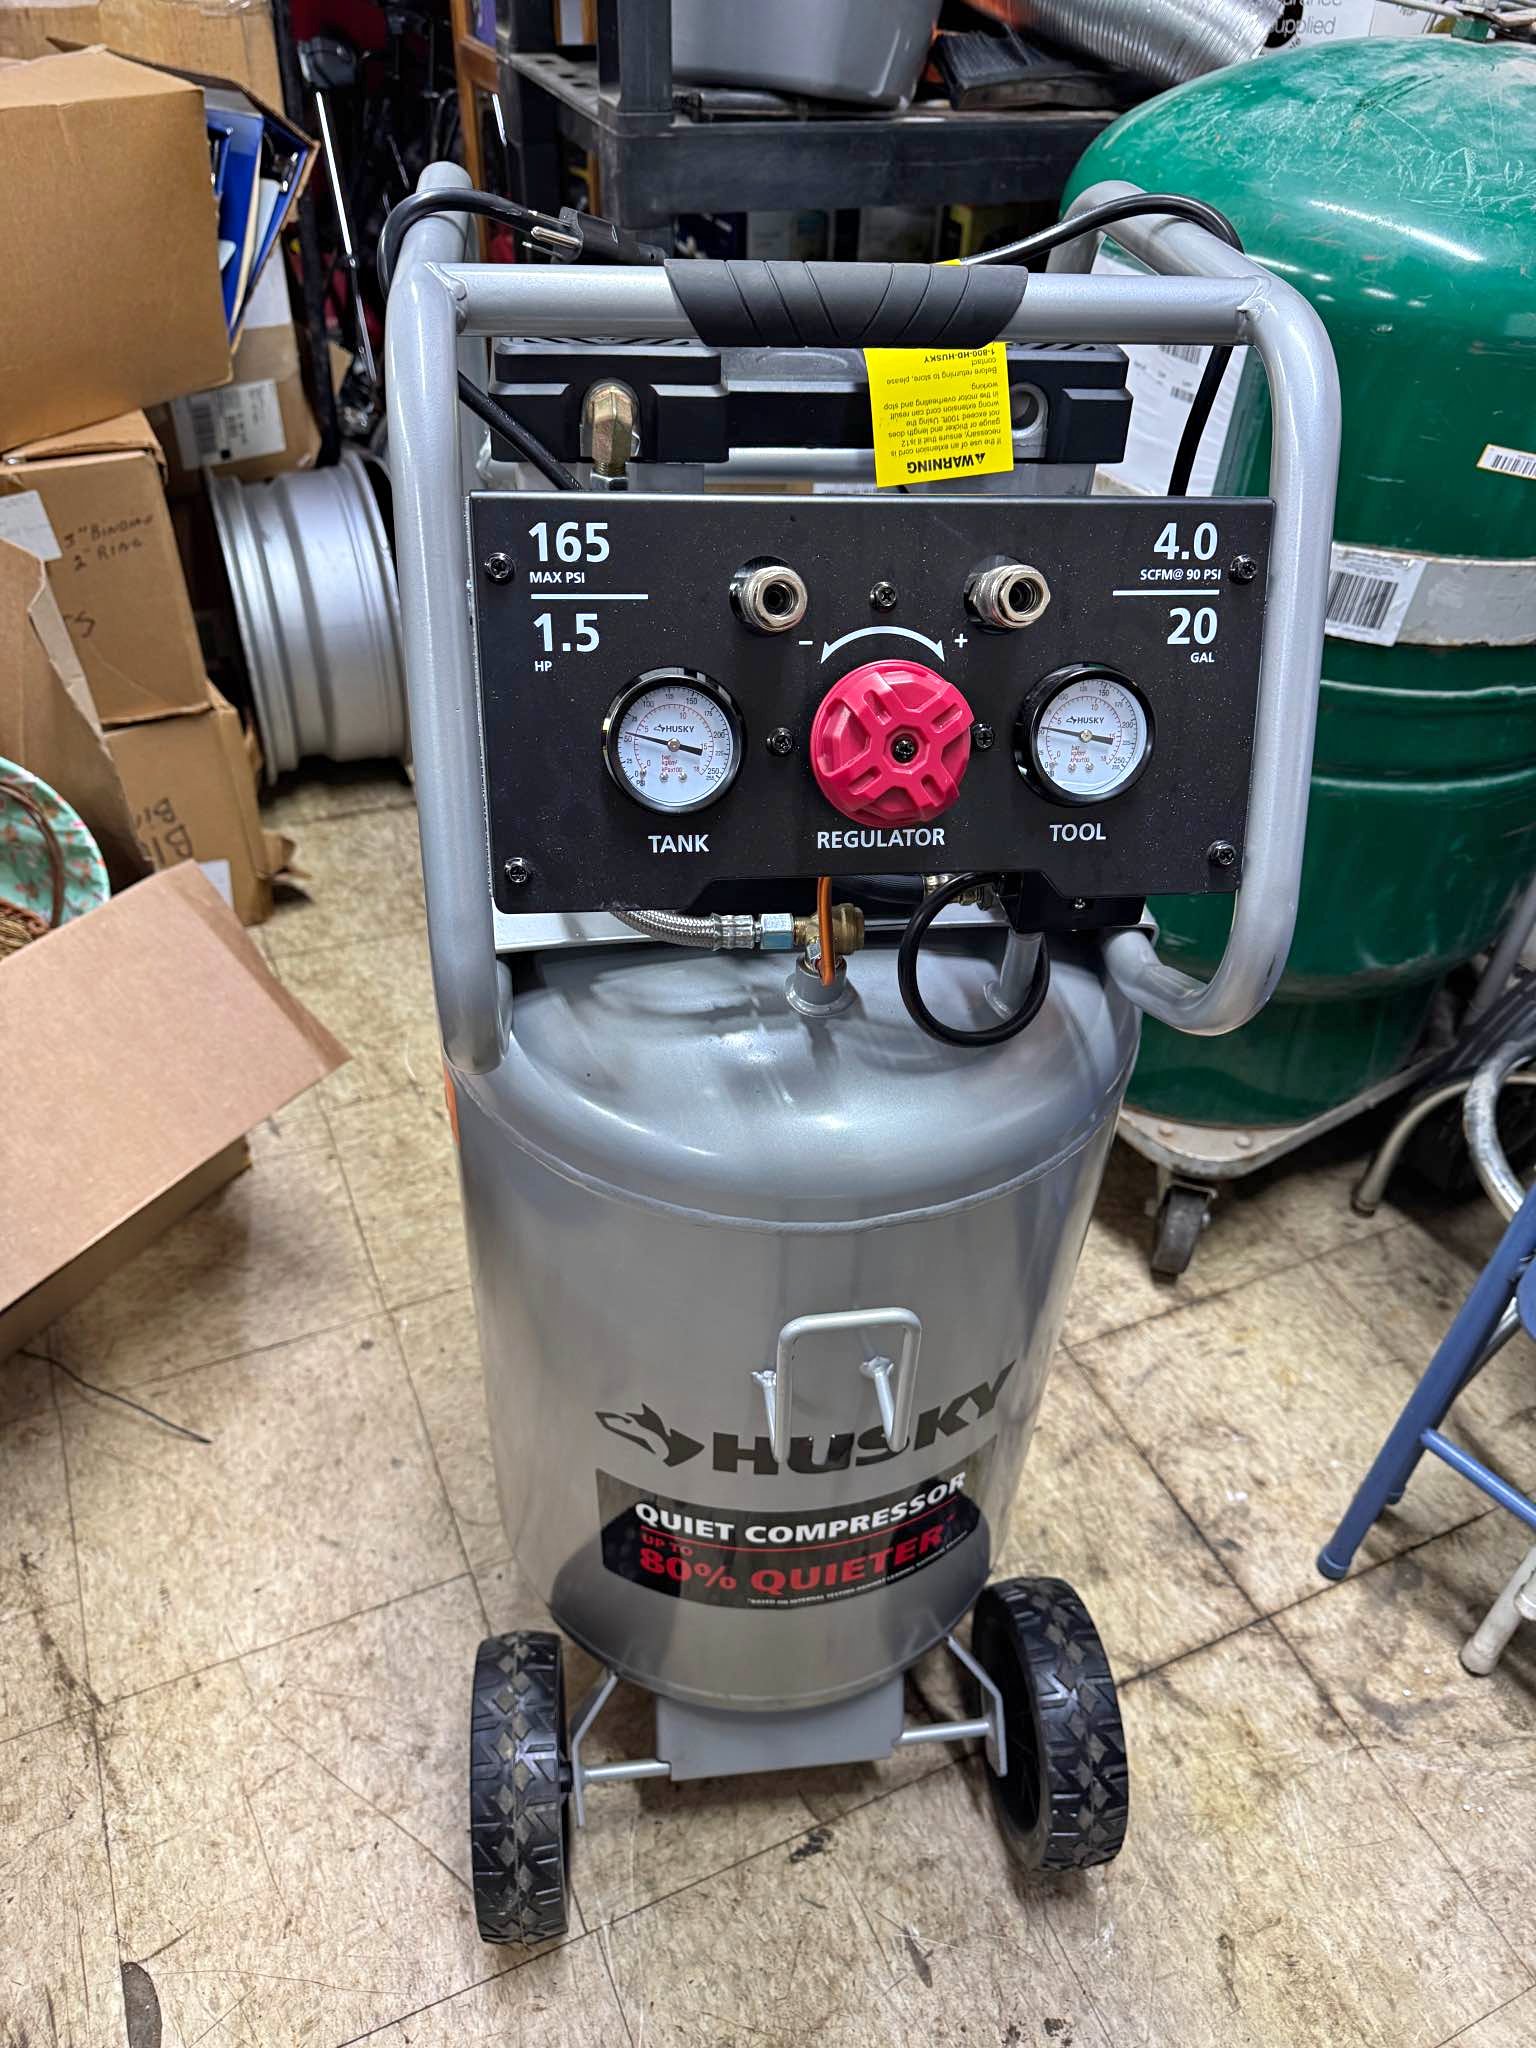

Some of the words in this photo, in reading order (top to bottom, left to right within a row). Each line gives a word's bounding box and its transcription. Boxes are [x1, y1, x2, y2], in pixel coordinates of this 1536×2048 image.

[924, 349, 995, 363] 1-800-HD-HUSKY
[971, 358, 996, 366] contact
[942, 369, 972, 379] returning
[975, 367, 997, 375] Before
[887, 376, 909, 385] please
[933, 373, 940, 381] to
[958, 394, 977, 403] motor
[980, 392, 990, 400] the
[883, 402, 898, 411] stop
[901, 401, 913, 410] and
[915, 396, 956, 408] overheating
[977, 401, 999, 410] wrong
[912, 409, 924, 417] can
[926, 407, 941, 416] cord
[943, 403, 976, 414] extension
[890, 411, 909, 420] result
[963, 411, 987, 420] exceed
[989, 410, 999, 418] not
[918, 414, 939, 426] Using
[979, 417, 1000, 427] gauge
[907, 426, 928, 437] length
[930, 426, 944, 434] and
[945, 423, 968, 432] thicker
[924, 436, 937, 444] that
[938, 433, 963, 441] ensure
[961, 441, 968, 449] of
[984, 439, 995, 447] the
[899, 448, 913, 456] cord
[916, 443, 948, 454] extension
[907, 454, 974, 473] WARNING
[529, 521, 610, 563] 165
[1153, 522, 1218, 561] 4.0
[530, 571, 562, 584] MAX
[565, 571, 585, 584] PSI
[1140, 568, 1184, 581] SCFM@
[1186, 568, 1201, 581] 90
[1203, 568, 1221, 581] PSI
[1167, 607, 1218, 645] 20
[533, 612, 600, 653] 1.5
[1190, 652, 1216, 664] GAL
[534, 660, 553, 672] HP
[1099, 689, 1110, 698] 150
[642, 700, 655, 709] 100
[686, 697, 698, 706] 150
[1077, 717, 1105, 725] HUSKY
[665, 724, 695, 734] HUSKY
[713, 731, 726, 740] 200
[708, 767, 721, 776] 250
[1049, 822, 1107, 842] TOOL
[816, 828, 946, 849] REGULATOR
[647, 834, 710, 854] TANK
[712, 1359, 1017, 1475] HUSKY
[635, 1503, 735, 1542] QUIET
[744, 1471, 967, 1544] COMPRESSOR
[641, 1532, 665, 1548] UP
[670, 1542, 694, 1557] TO
[640, 1547, 738, 1592] 80%
